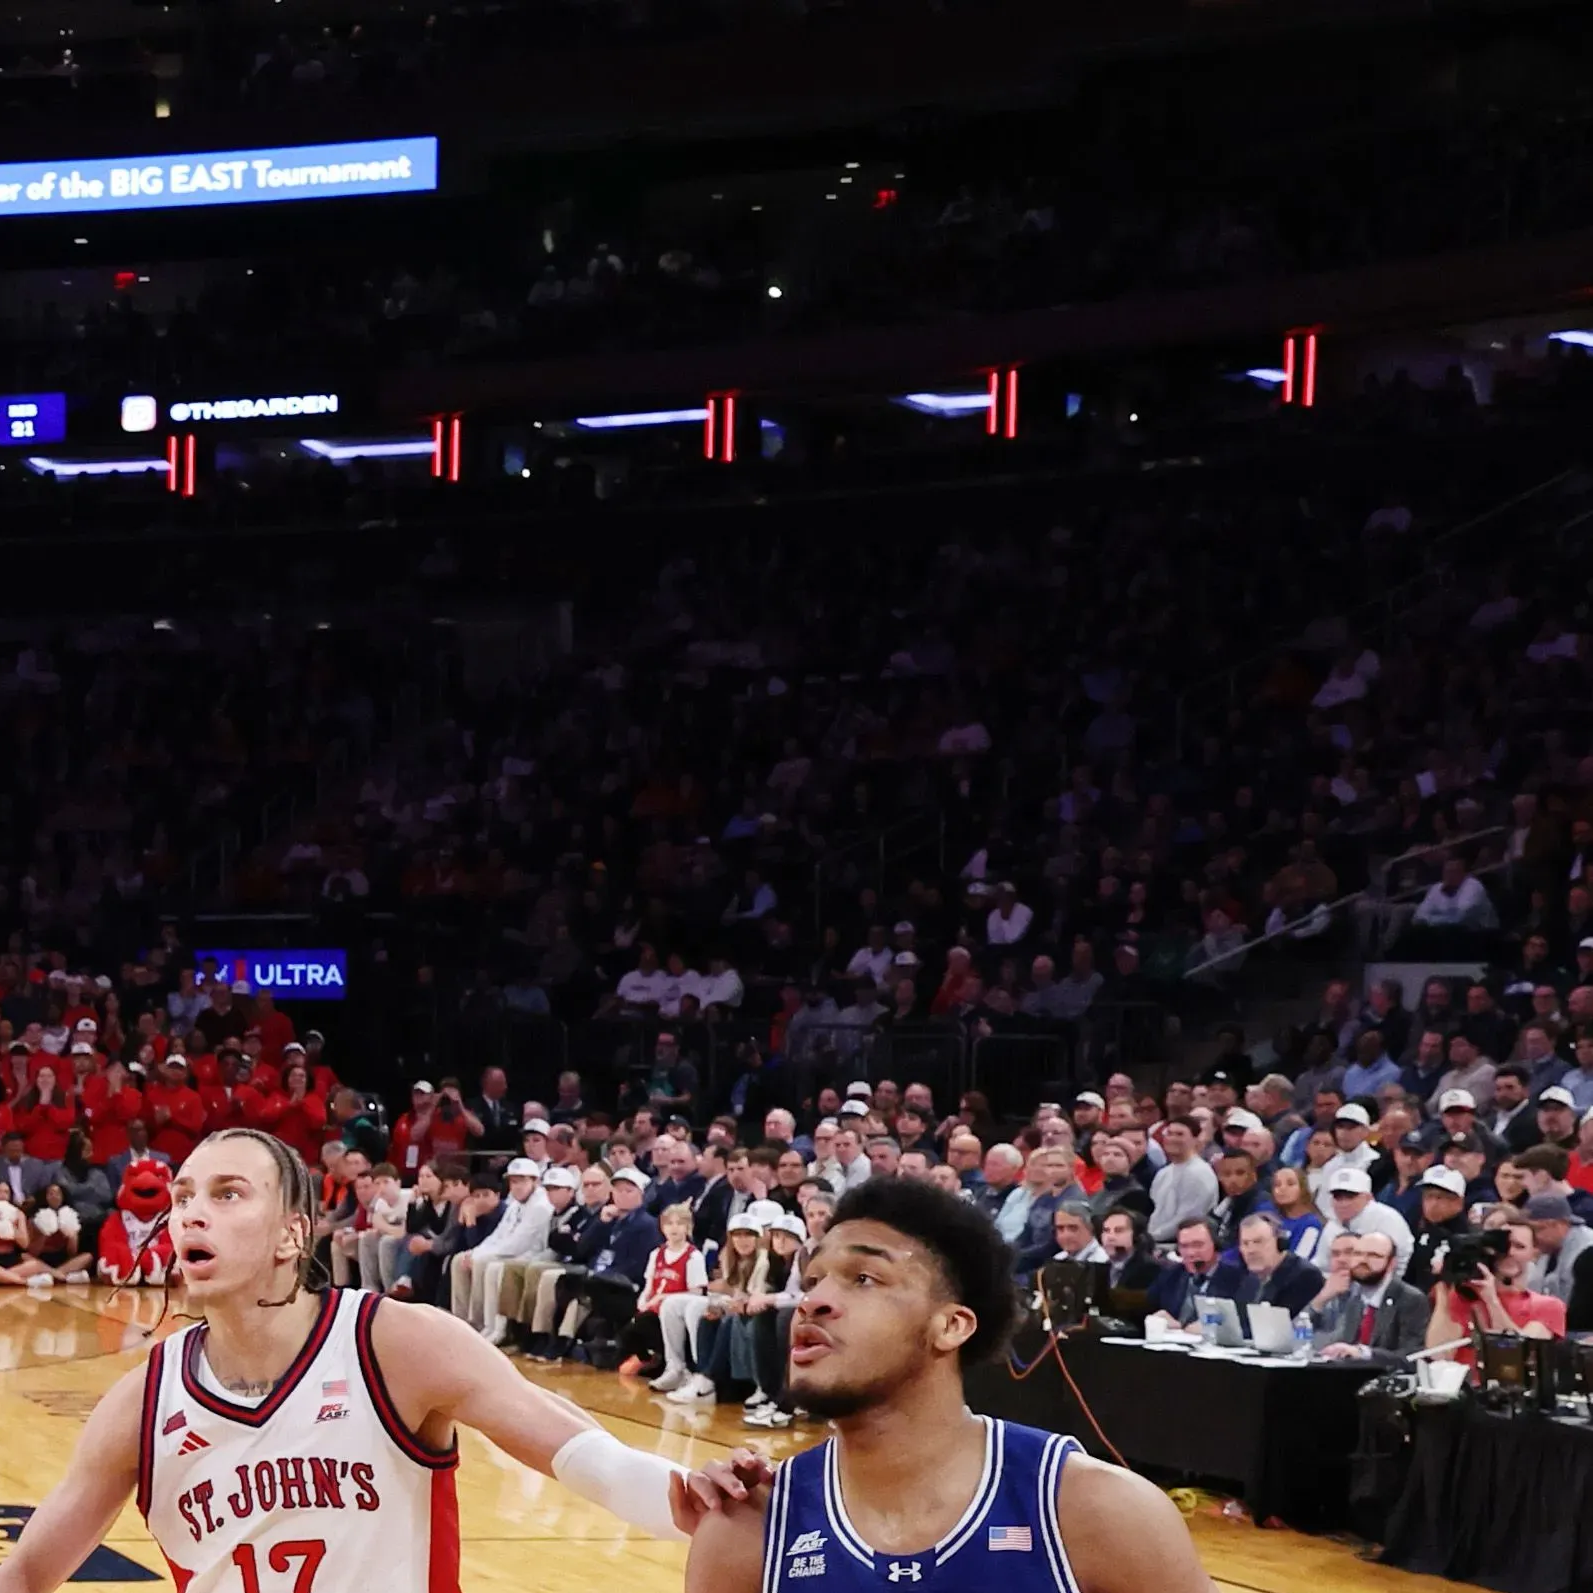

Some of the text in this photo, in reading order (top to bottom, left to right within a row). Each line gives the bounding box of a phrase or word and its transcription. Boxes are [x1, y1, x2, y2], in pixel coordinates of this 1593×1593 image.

[26, 172, 57, 201] of
[60, 171, 104, 200] the
[110, 167, 163, 198] BIG
[170, 162, 247, 192] EAST
[252, 155, 411, 188] Tournament
[169, 394, 339, 421] @THEGARDEN
[254, 963, 344, 986] ULTRA
[178, 1457, 380, 1543] ST. JOHN'S
[788, 1565, 826, 1579] CHANGE
[793, 1554, 825, 1567] BE THE
